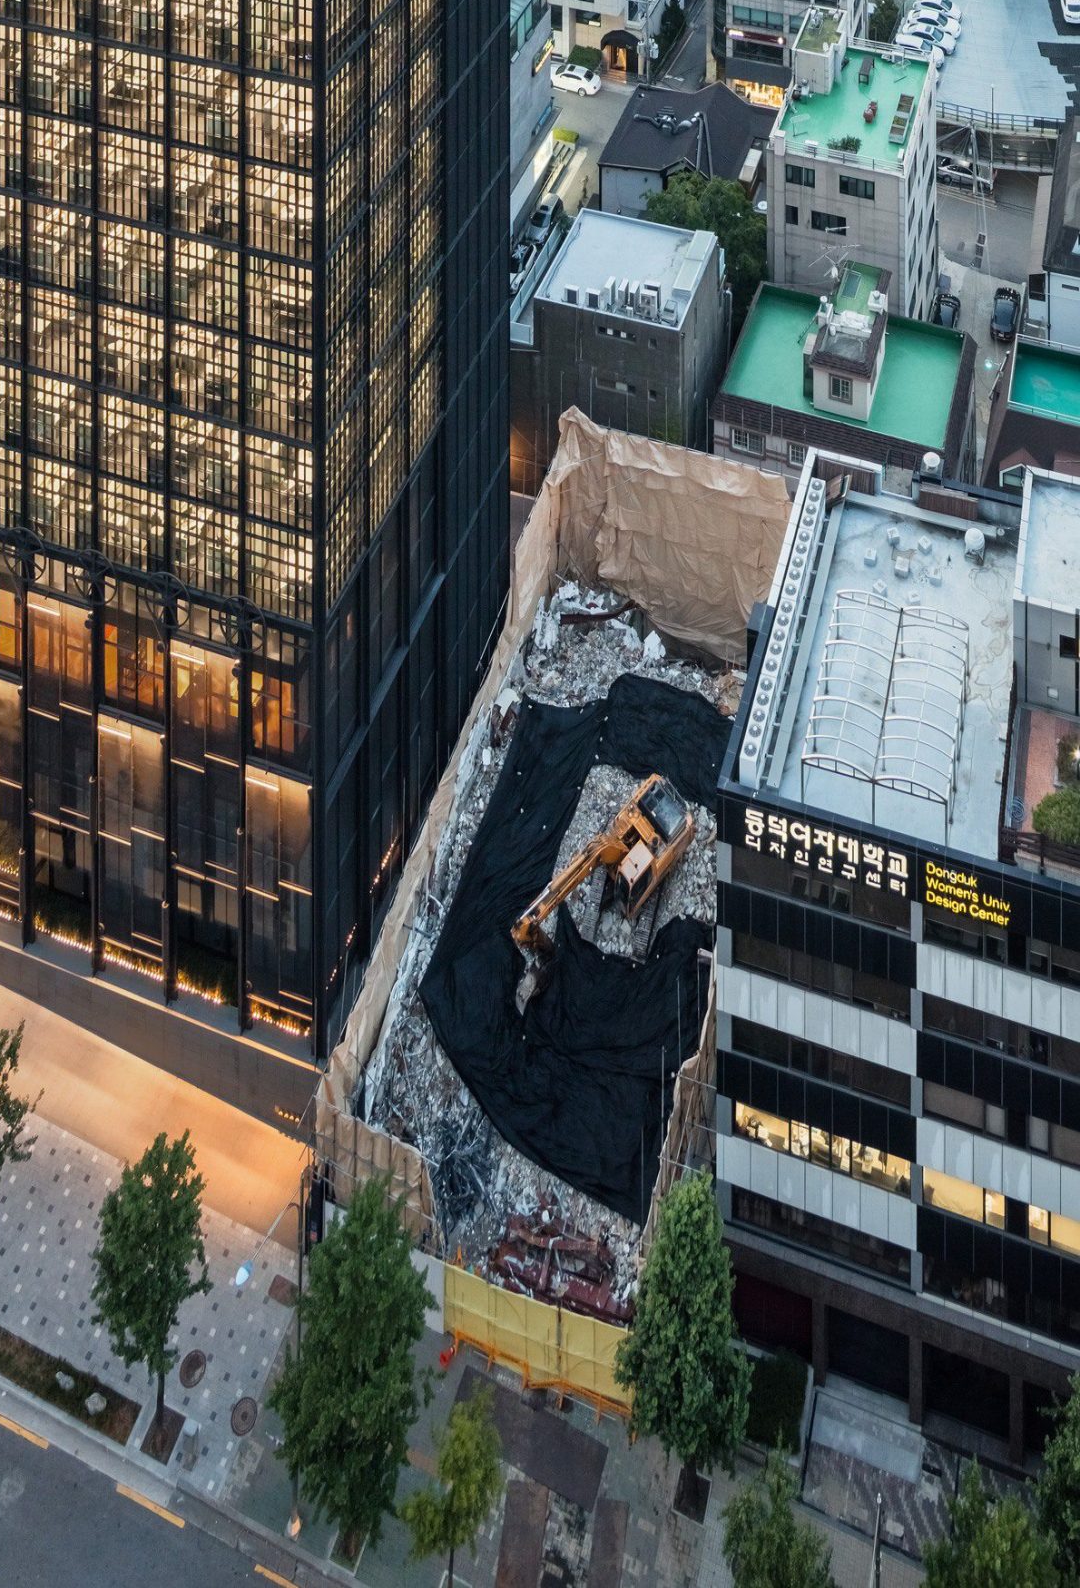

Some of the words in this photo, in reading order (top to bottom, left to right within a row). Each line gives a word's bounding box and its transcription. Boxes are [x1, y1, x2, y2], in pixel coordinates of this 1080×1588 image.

[744, 807, 909, 879] 동덕여자대학교
[925, 861, 978, 888] Dongduk
[925, 875, 979, 903] Women's
[982, 893, 1012, 913] Univ.
[925, 890, 967, 914] Design
[968, 904, 1010, 926] Center
